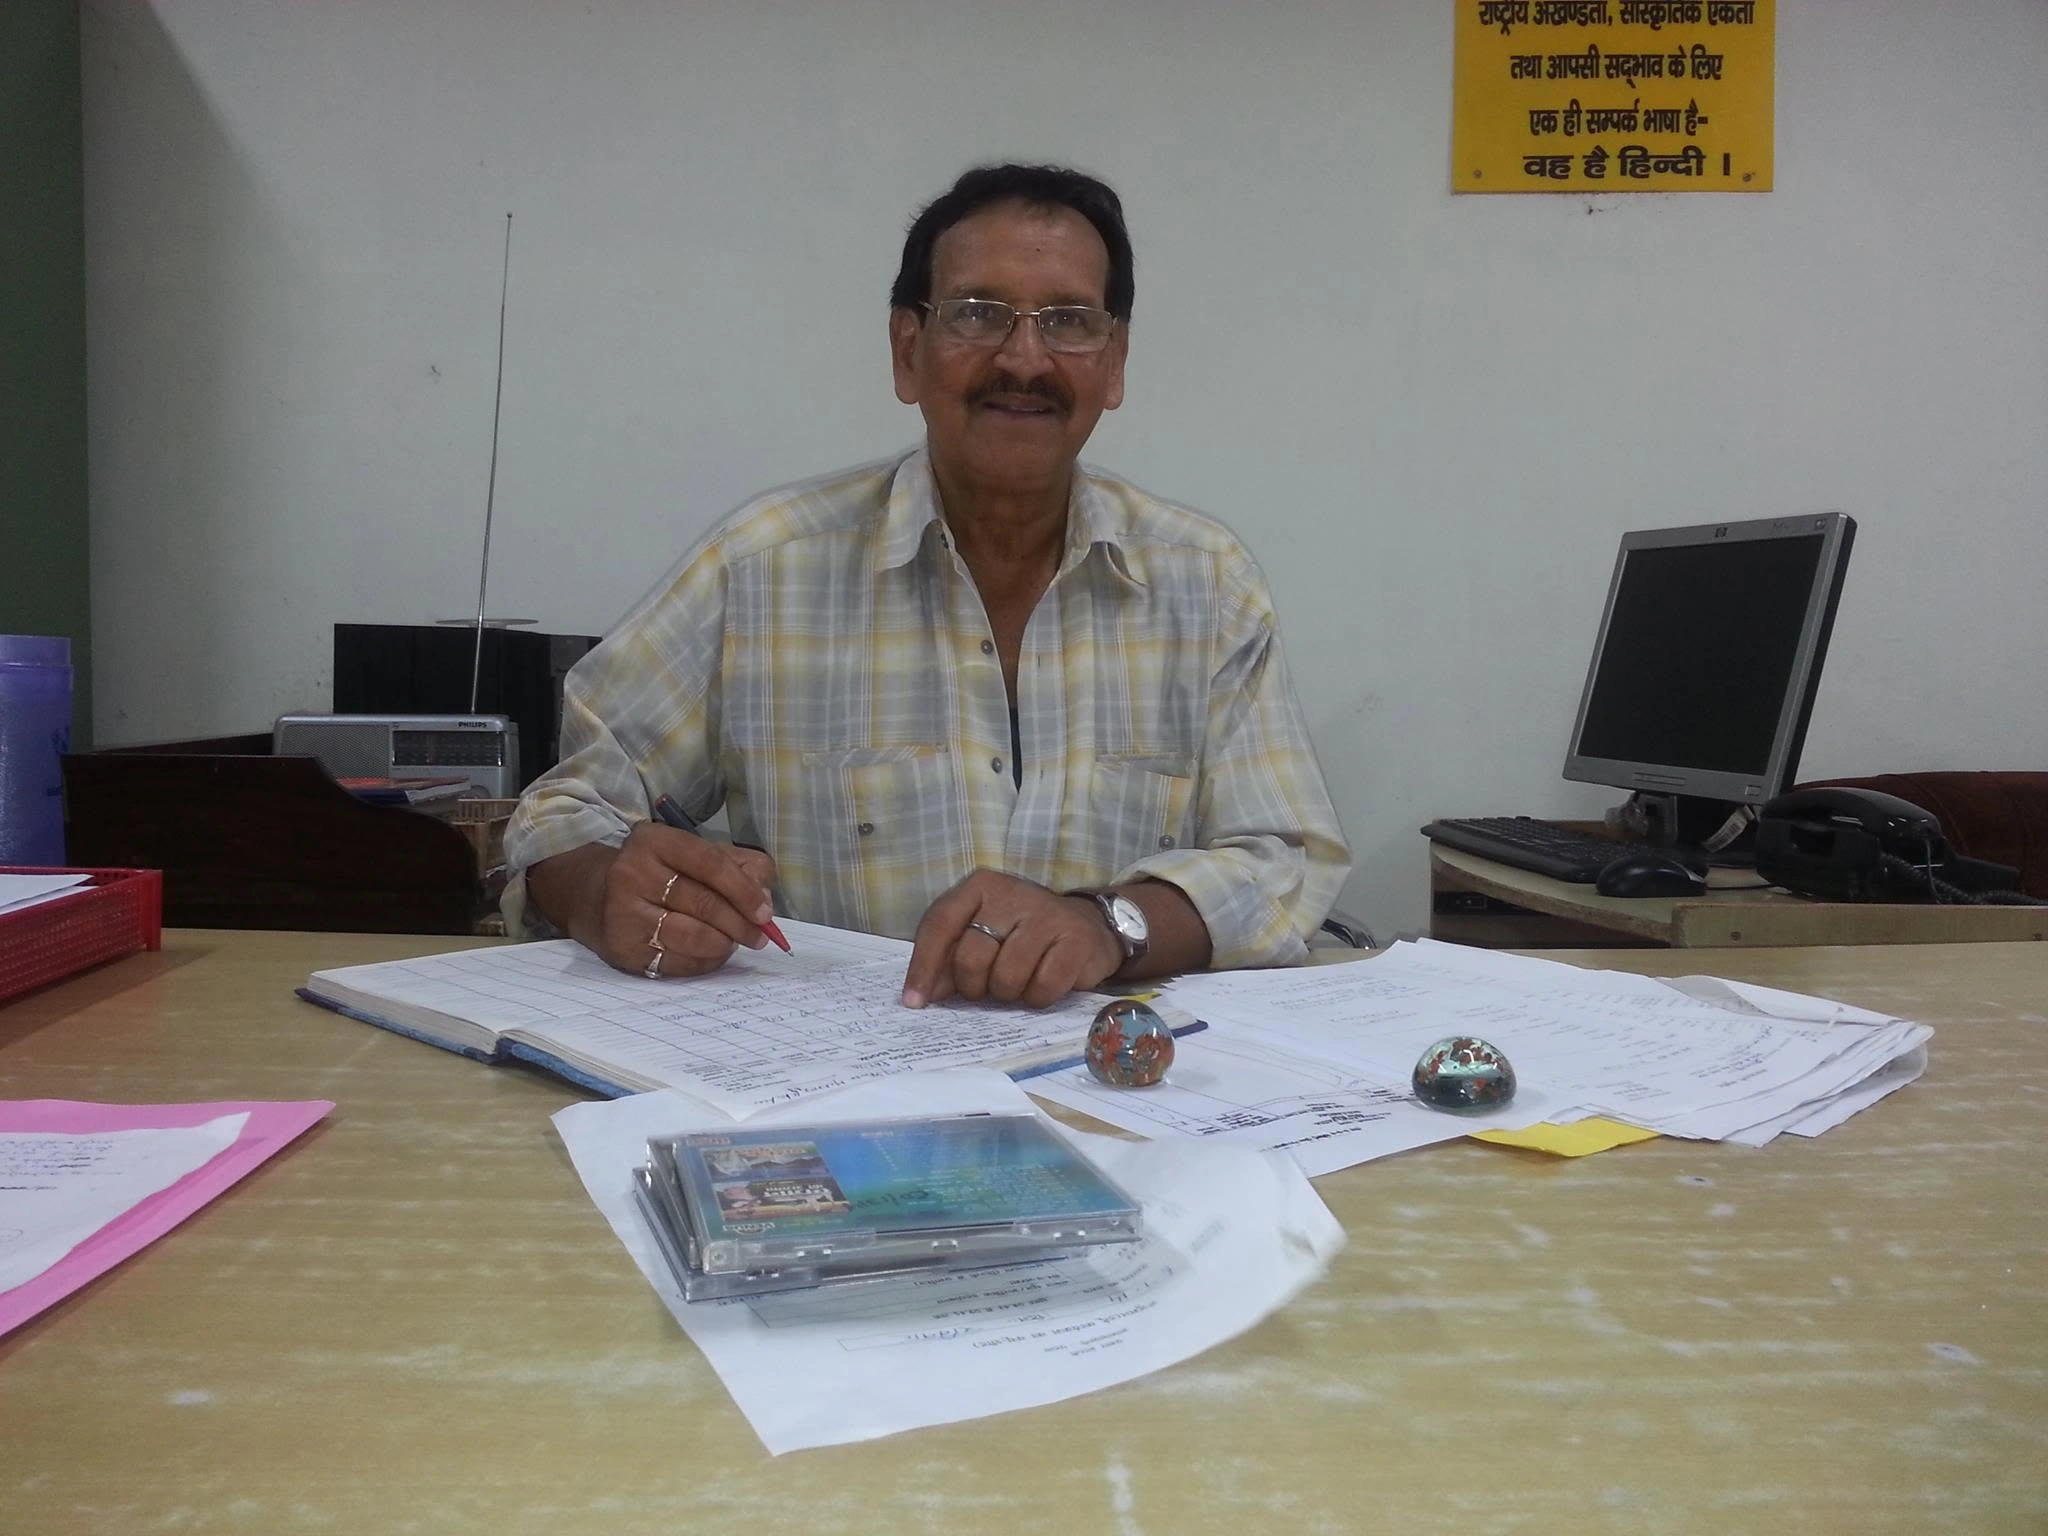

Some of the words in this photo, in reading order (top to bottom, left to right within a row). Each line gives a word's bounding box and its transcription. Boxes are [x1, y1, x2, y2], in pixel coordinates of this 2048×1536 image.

[1707, 0, 1754, 25] एकता
[1510, 55, 1542, 80] तथा
[1546, 44, 1600, 79] आपसी
[1668, 45, 1688, 79] के
[1690, 44, 1723, 80] लिए
[1529, 109, 1559, 135] एक
[1563, 98, 1582, 136] ही
[1586, 98, 1640, 133] सम्पर्क
[1643, 109, 1680, 133] भाषा
[1523, 155, 1574, 179] वह
[1583, 146, 1610, 179] है
[1617, 145, 1706, 179] हिन्दी
[457, 720, 488, 728] PHILIPS
